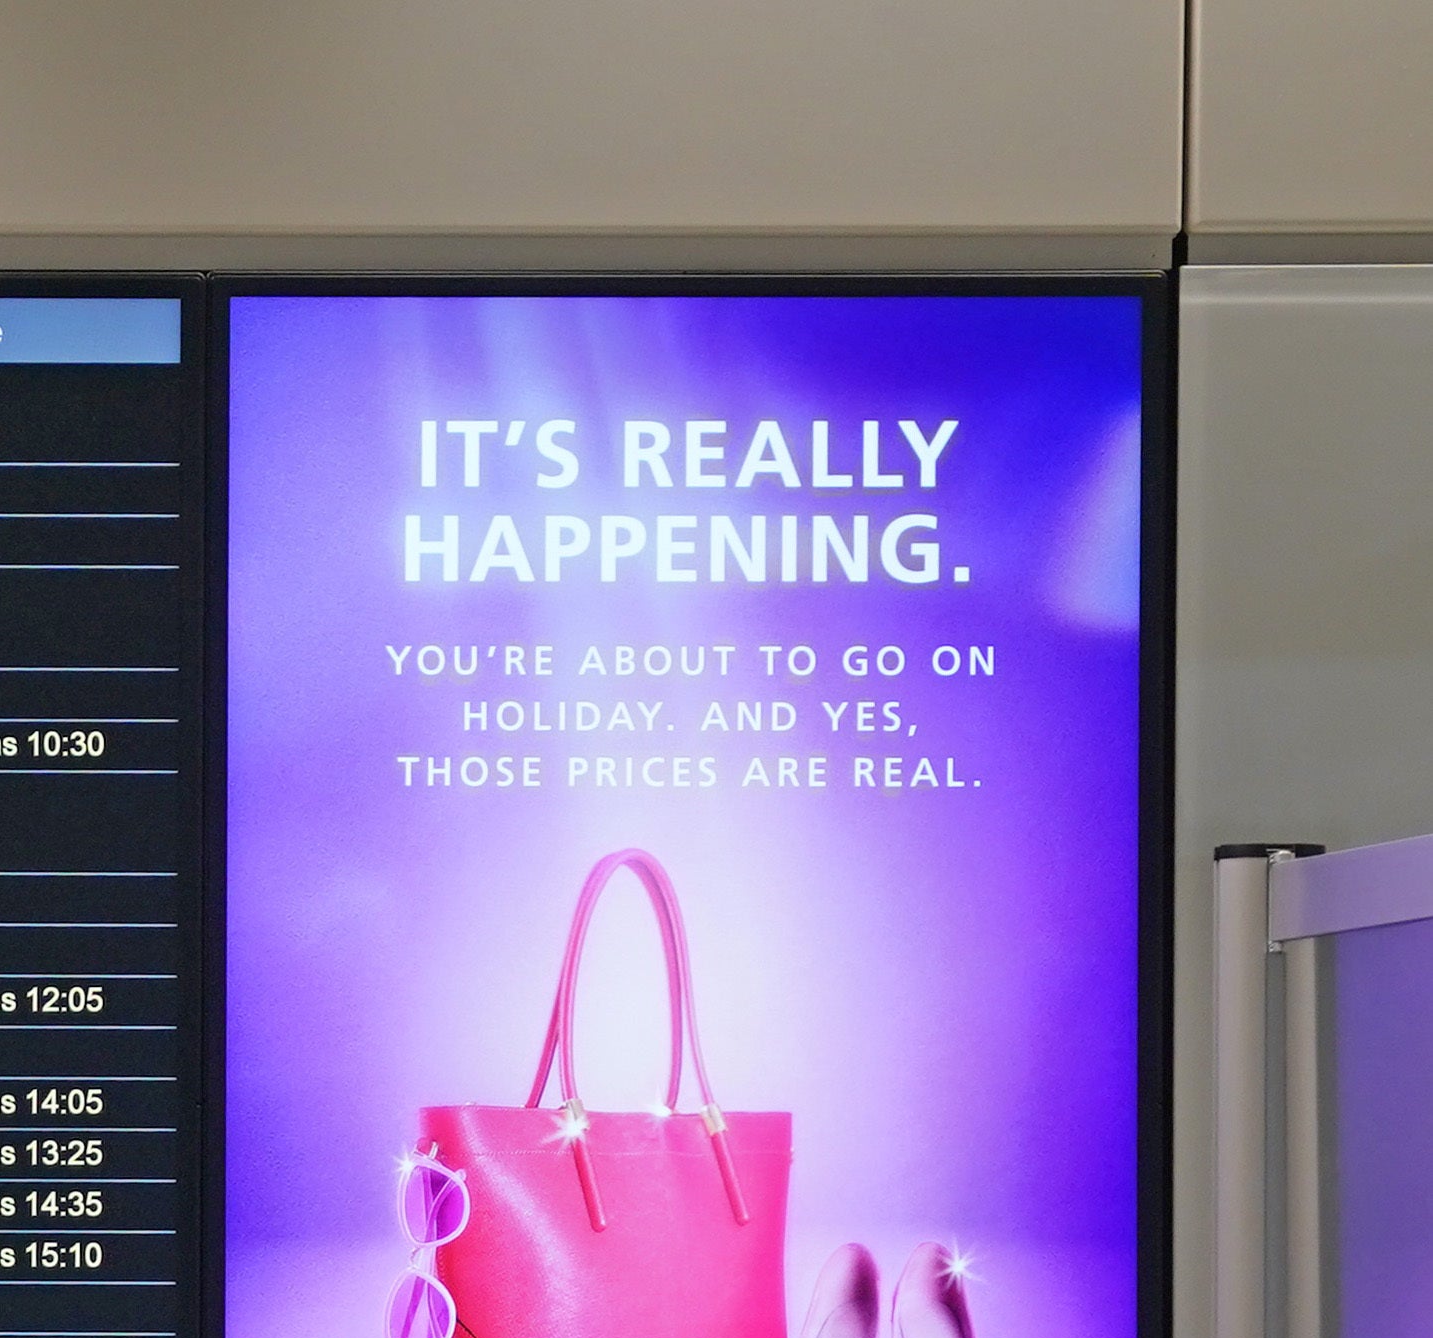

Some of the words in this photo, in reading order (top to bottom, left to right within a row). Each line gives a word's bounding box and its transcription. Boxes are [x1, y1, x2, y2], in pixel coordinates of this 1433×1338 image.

[624, 419, 960, 489] REALLY
[403, 515, 972, 585] HAPPENING.
[579, 644, 735, 675] ABOUT
[759, 646, 815, 675] TO
[843, 646, 904, 676] GO
[932, 646, 993, 676] ON
[462, 701, 677, 734] HOLIDAY.
[702, 701, 798, 734] AND
[822, 702, 916, 736] YES,
[28, 731, 104, 756] 10:30
[398, 756, 543, 789] THOSE
[567, 756, 718, 789] PRICES
[742, 756, 831, 789] ARE
[854, 757, 980, 787] REAL.
